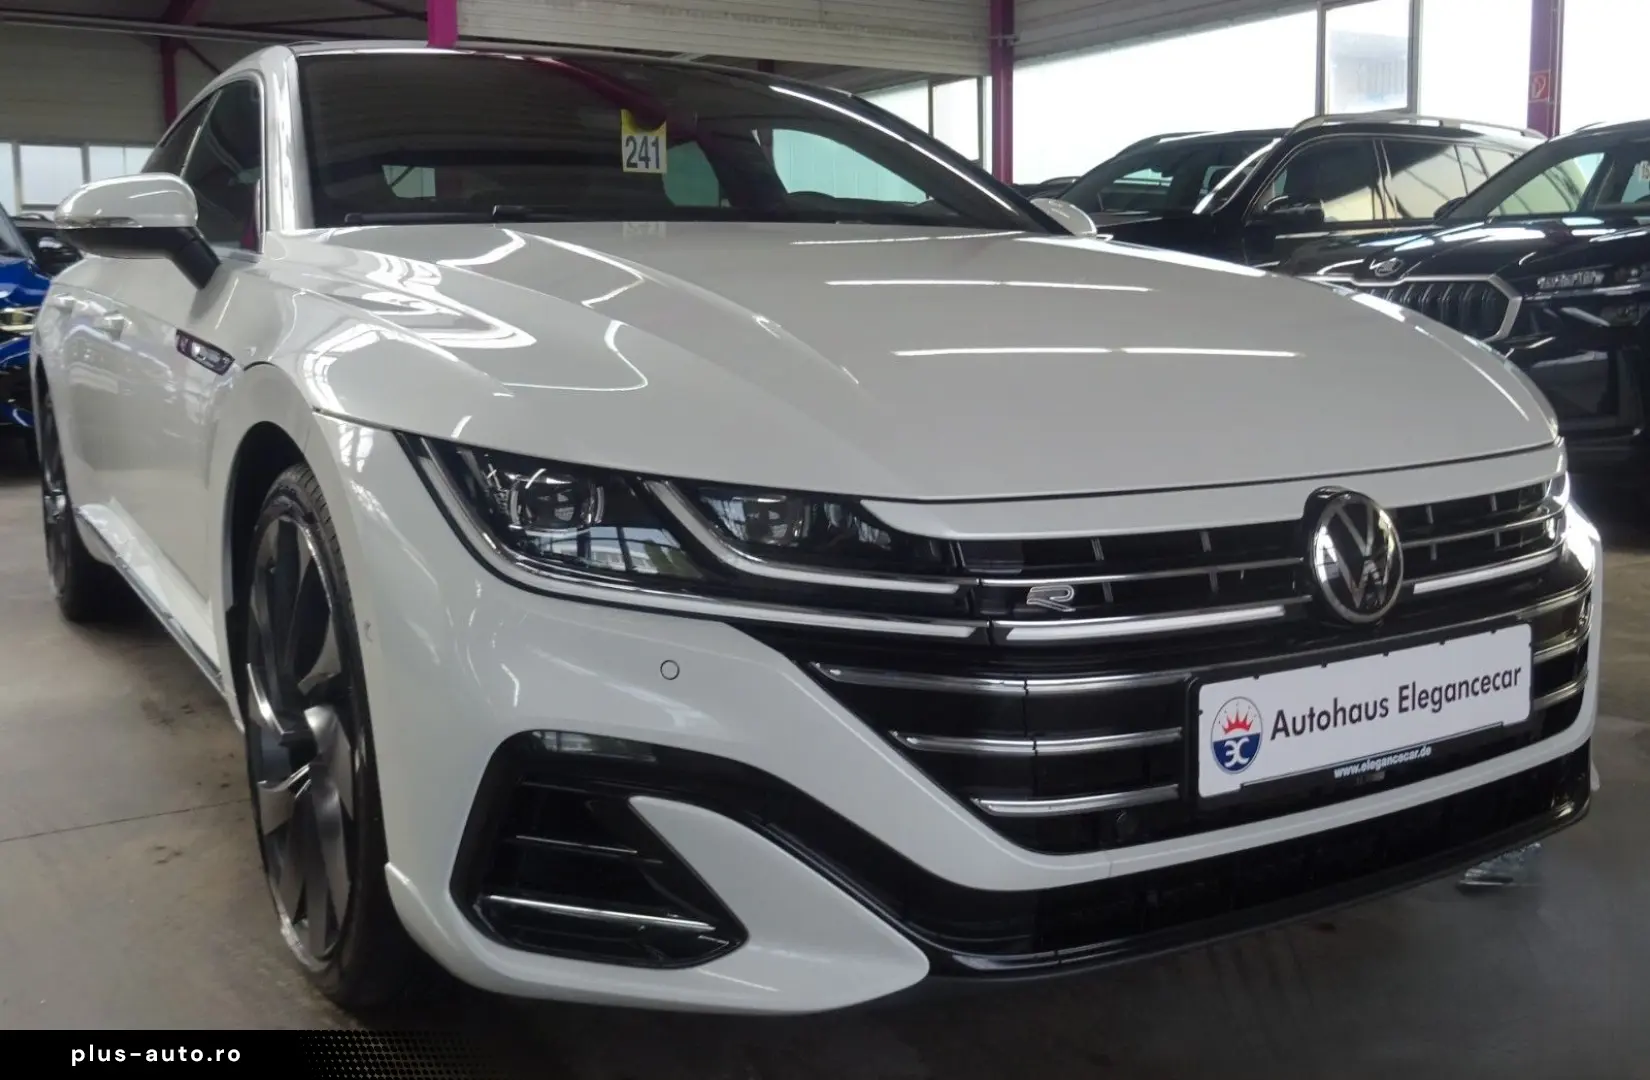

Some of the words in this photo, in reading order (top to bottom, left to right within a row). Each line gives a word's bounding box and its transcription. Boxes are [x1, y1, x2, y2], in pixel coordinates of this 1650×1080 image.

[625, 135, 660, 169] 241
[1270, 697, 1389, 741] Autohaus
[1398, 666, 1522, 714] Elegancecar
[1333, 745, 1432, 779] www.elegancecar.de
